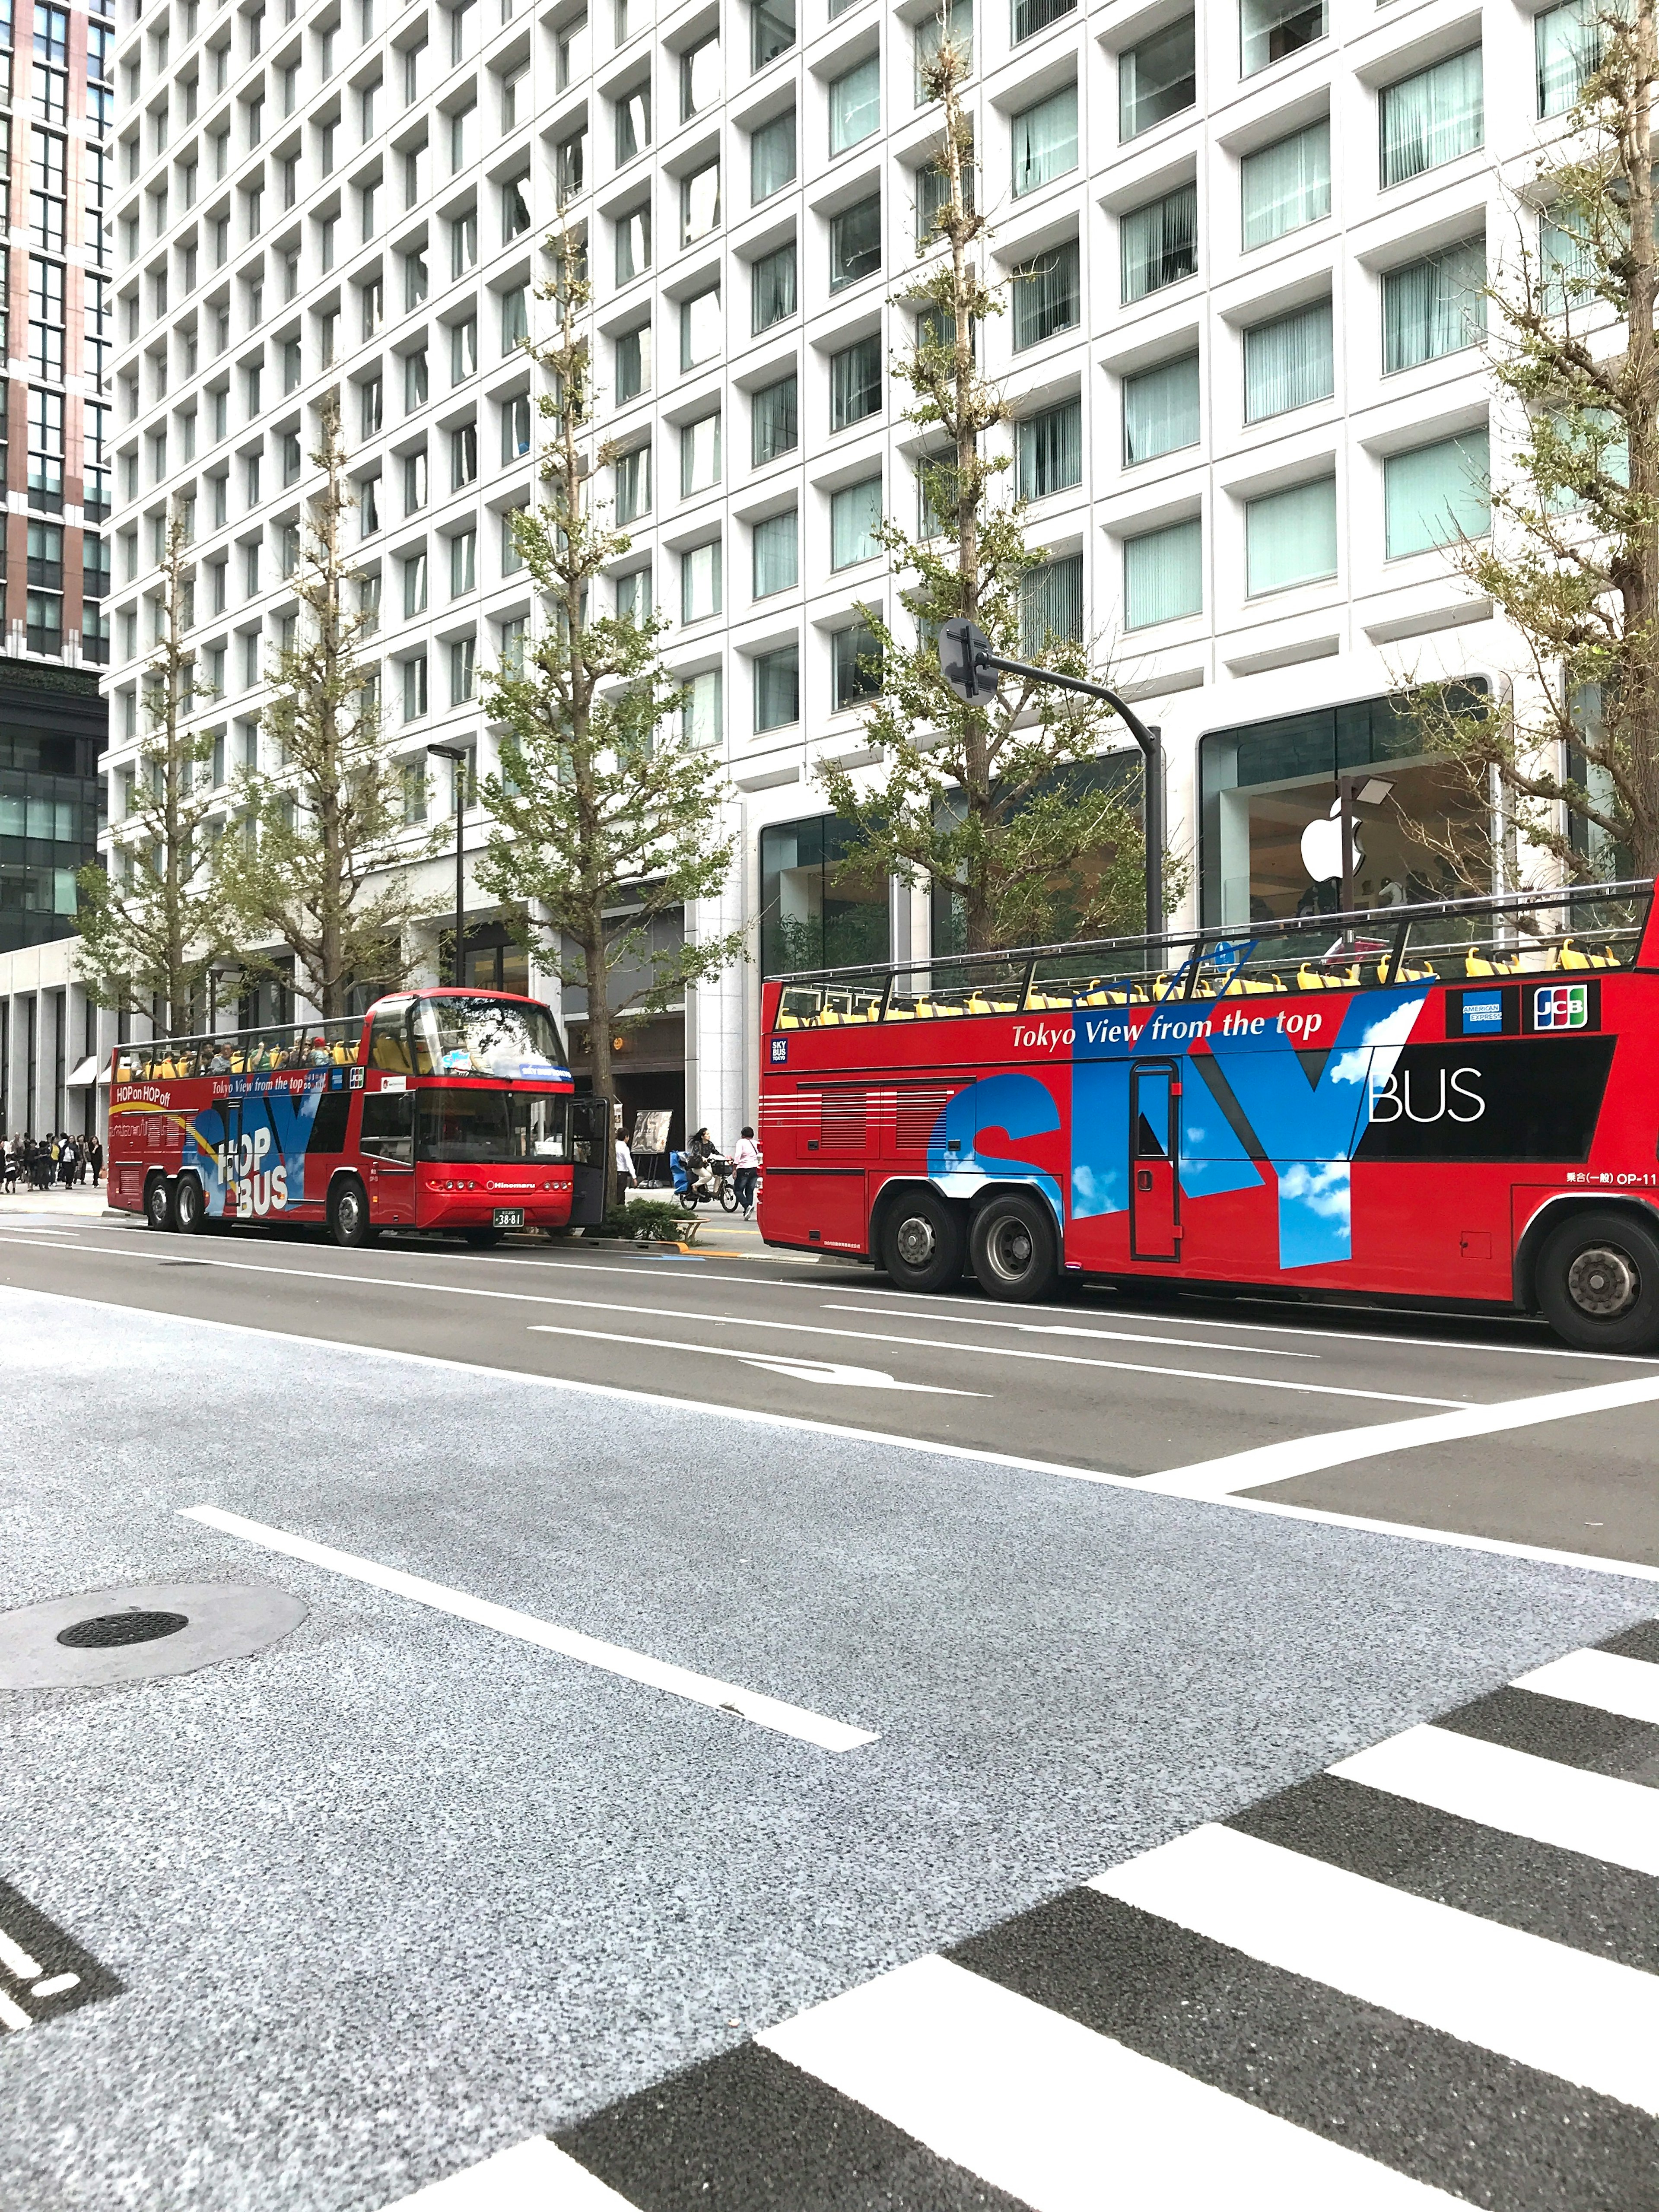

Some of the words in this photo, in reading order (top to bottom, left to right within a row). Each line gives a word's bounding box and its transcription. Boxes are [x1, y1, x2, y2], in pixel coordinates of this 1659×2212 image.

[1012, 1022, 1076, 1053] Tokyo
[1086, 1018, 1144, 1045] View
[1152, 1015, 1212, 1040] from
[1223, 1009, 1265, 1036] the
[1276, 1010, 1322, 1041] top
[117, 1086, 133, 1102] HOP
[133, 1089, 142, 1100] on
[143, 1086, 159, 1102] HOP
[160, 1092, 172, 1107] off
[213, 1081, 233, 1097] Tokyo
[235, 1080, 254, 1093] View
[255, 1078, 273, 1091] from
[275, 1076, 287, 1090] the
[289, 1077, 303, 1093] top
[1369, 1068, 1486, 1123] BUS
[927, 939, 1440, 1269] SKY
[218, 1127, 270, 1185] HOP
[236, 1165, 288, 1218] BUS
[1567, 1172, 1614, 1184] 乗合(一般)
[1617, 1173, 1656, 1185] OP-11
[499, 1214, 520, 1224] 38-81
